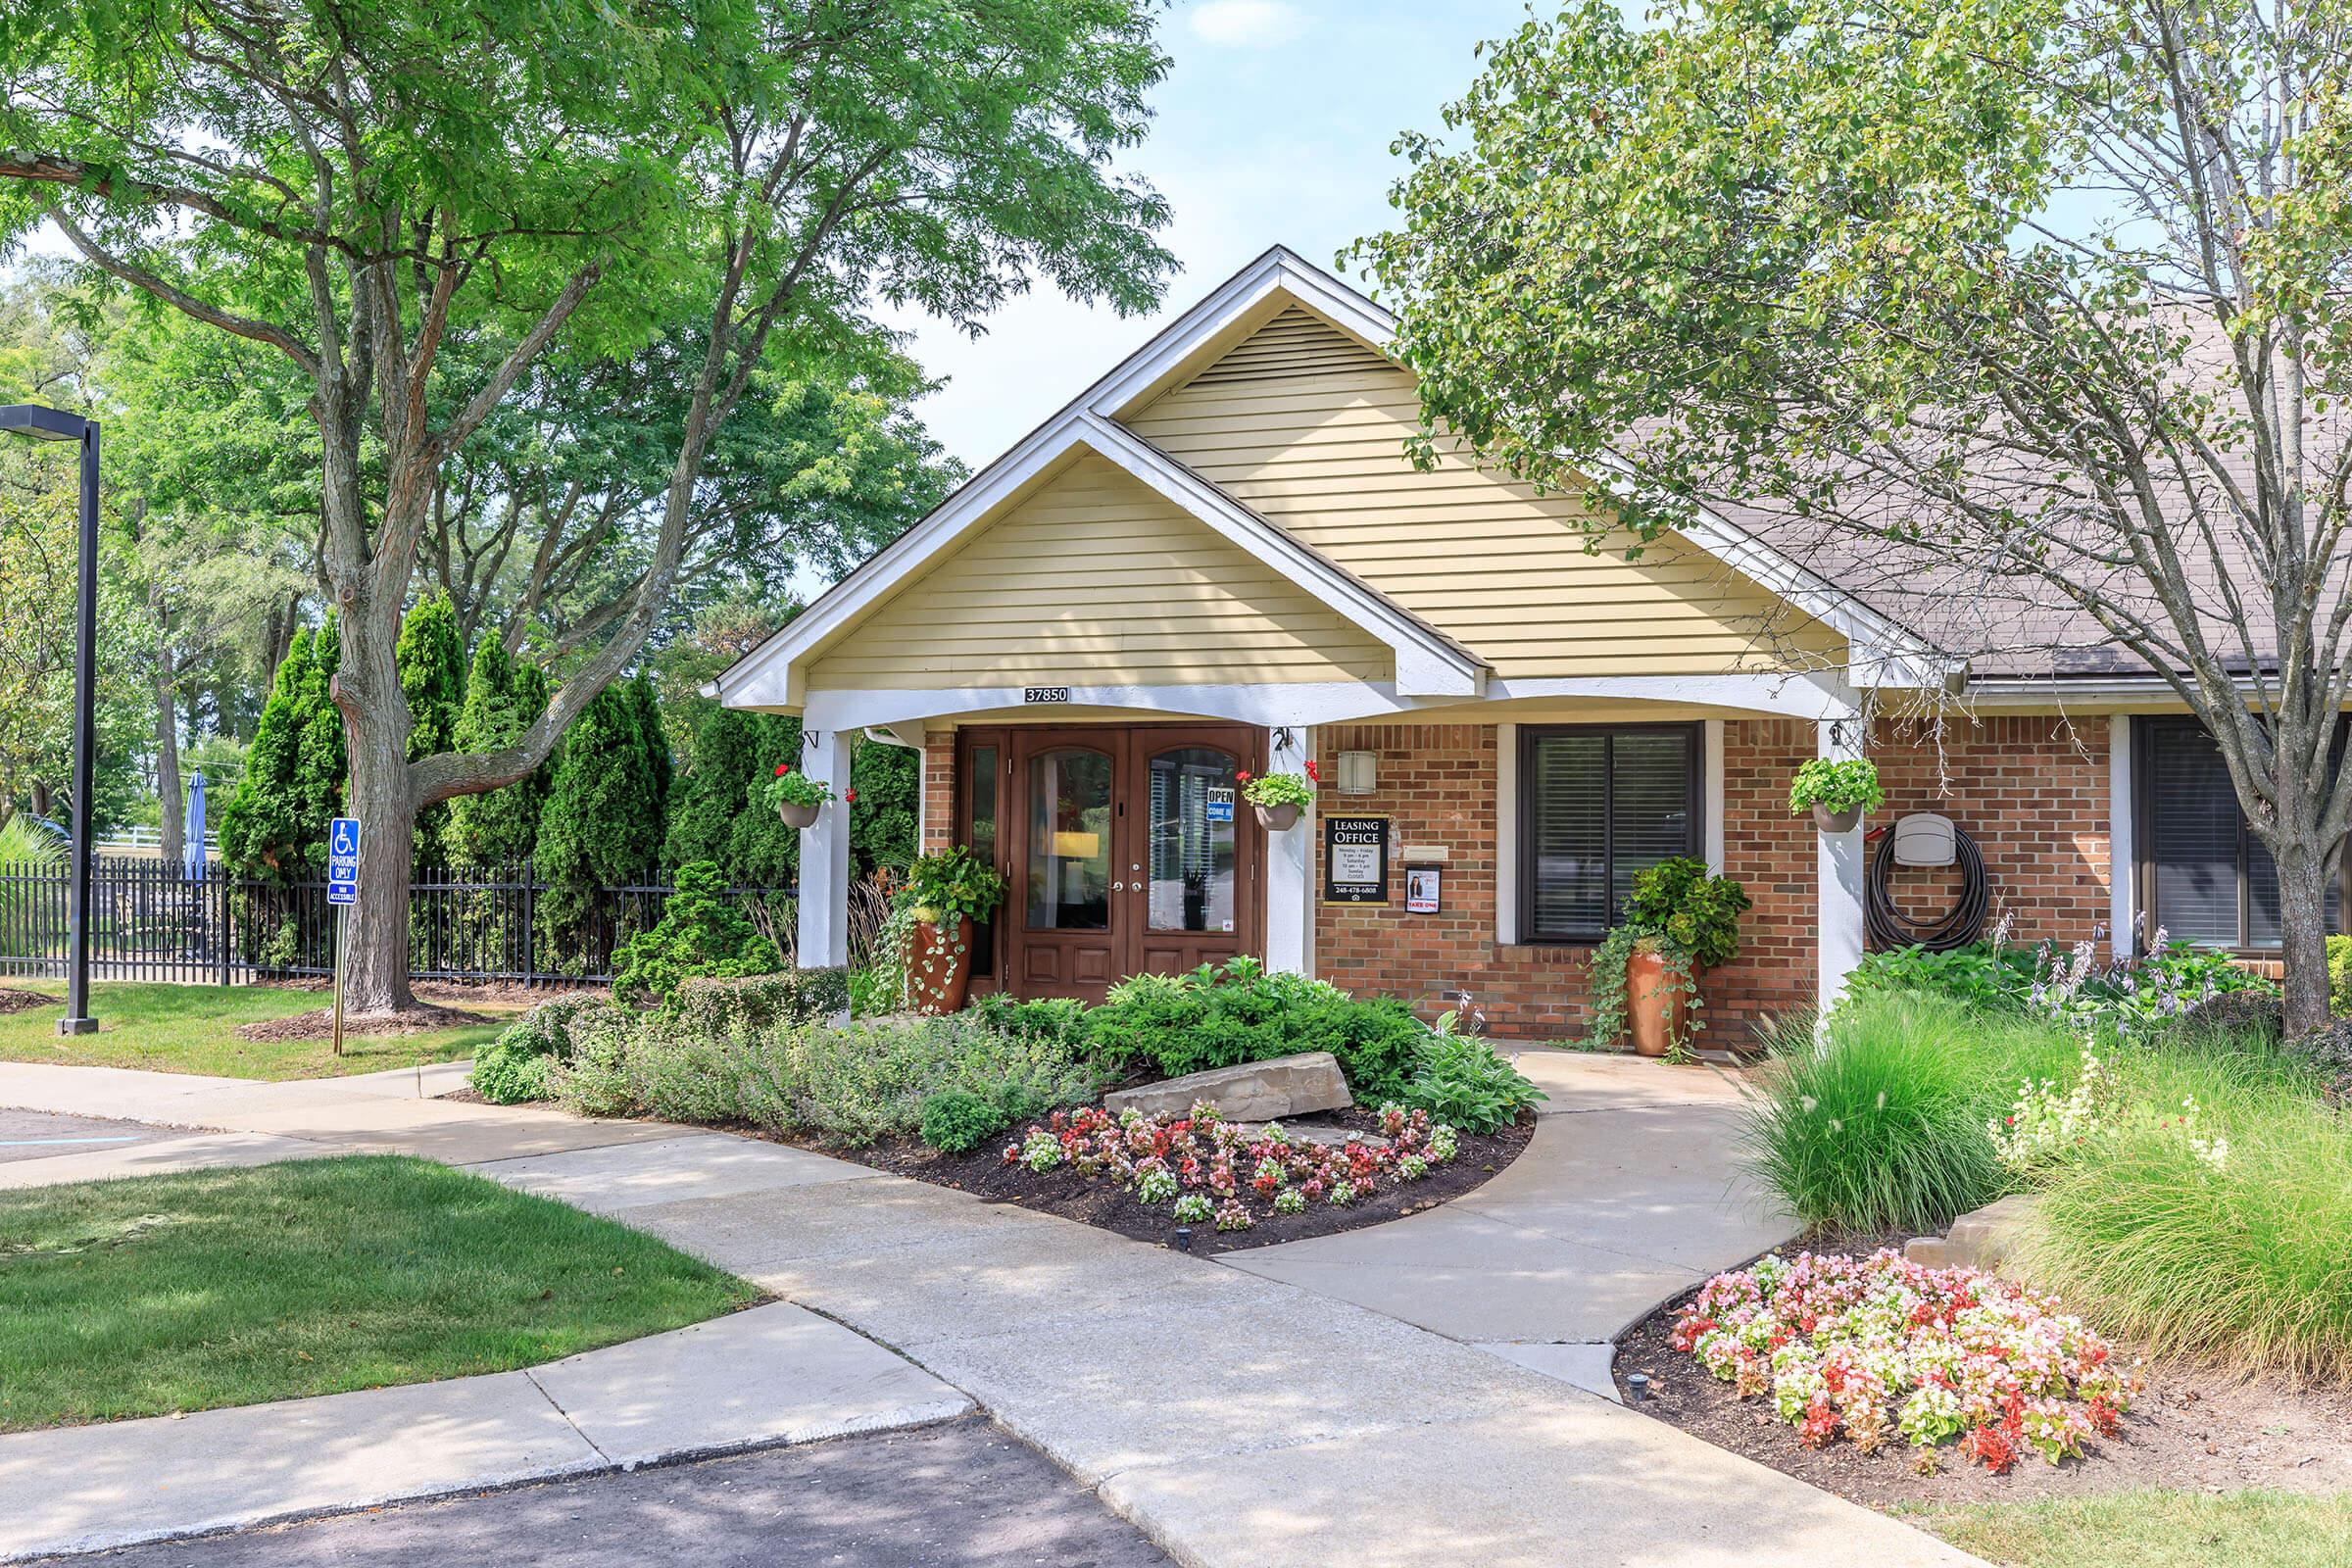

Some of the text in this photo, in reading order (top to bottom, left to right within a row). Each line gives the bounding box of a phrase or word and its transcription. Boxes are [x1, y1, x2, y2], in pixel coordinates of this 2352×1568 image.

[1027, 689, 1066, 701] 37850
[1209, 790, 1234, 803] OPEN
[1335, 820, 1379, 831] LEASING
[1335, 832, 1379, 843] OFFICE
[332, 855, 356, 867] PARKING
[335, 867, 352, 878] ONLY
